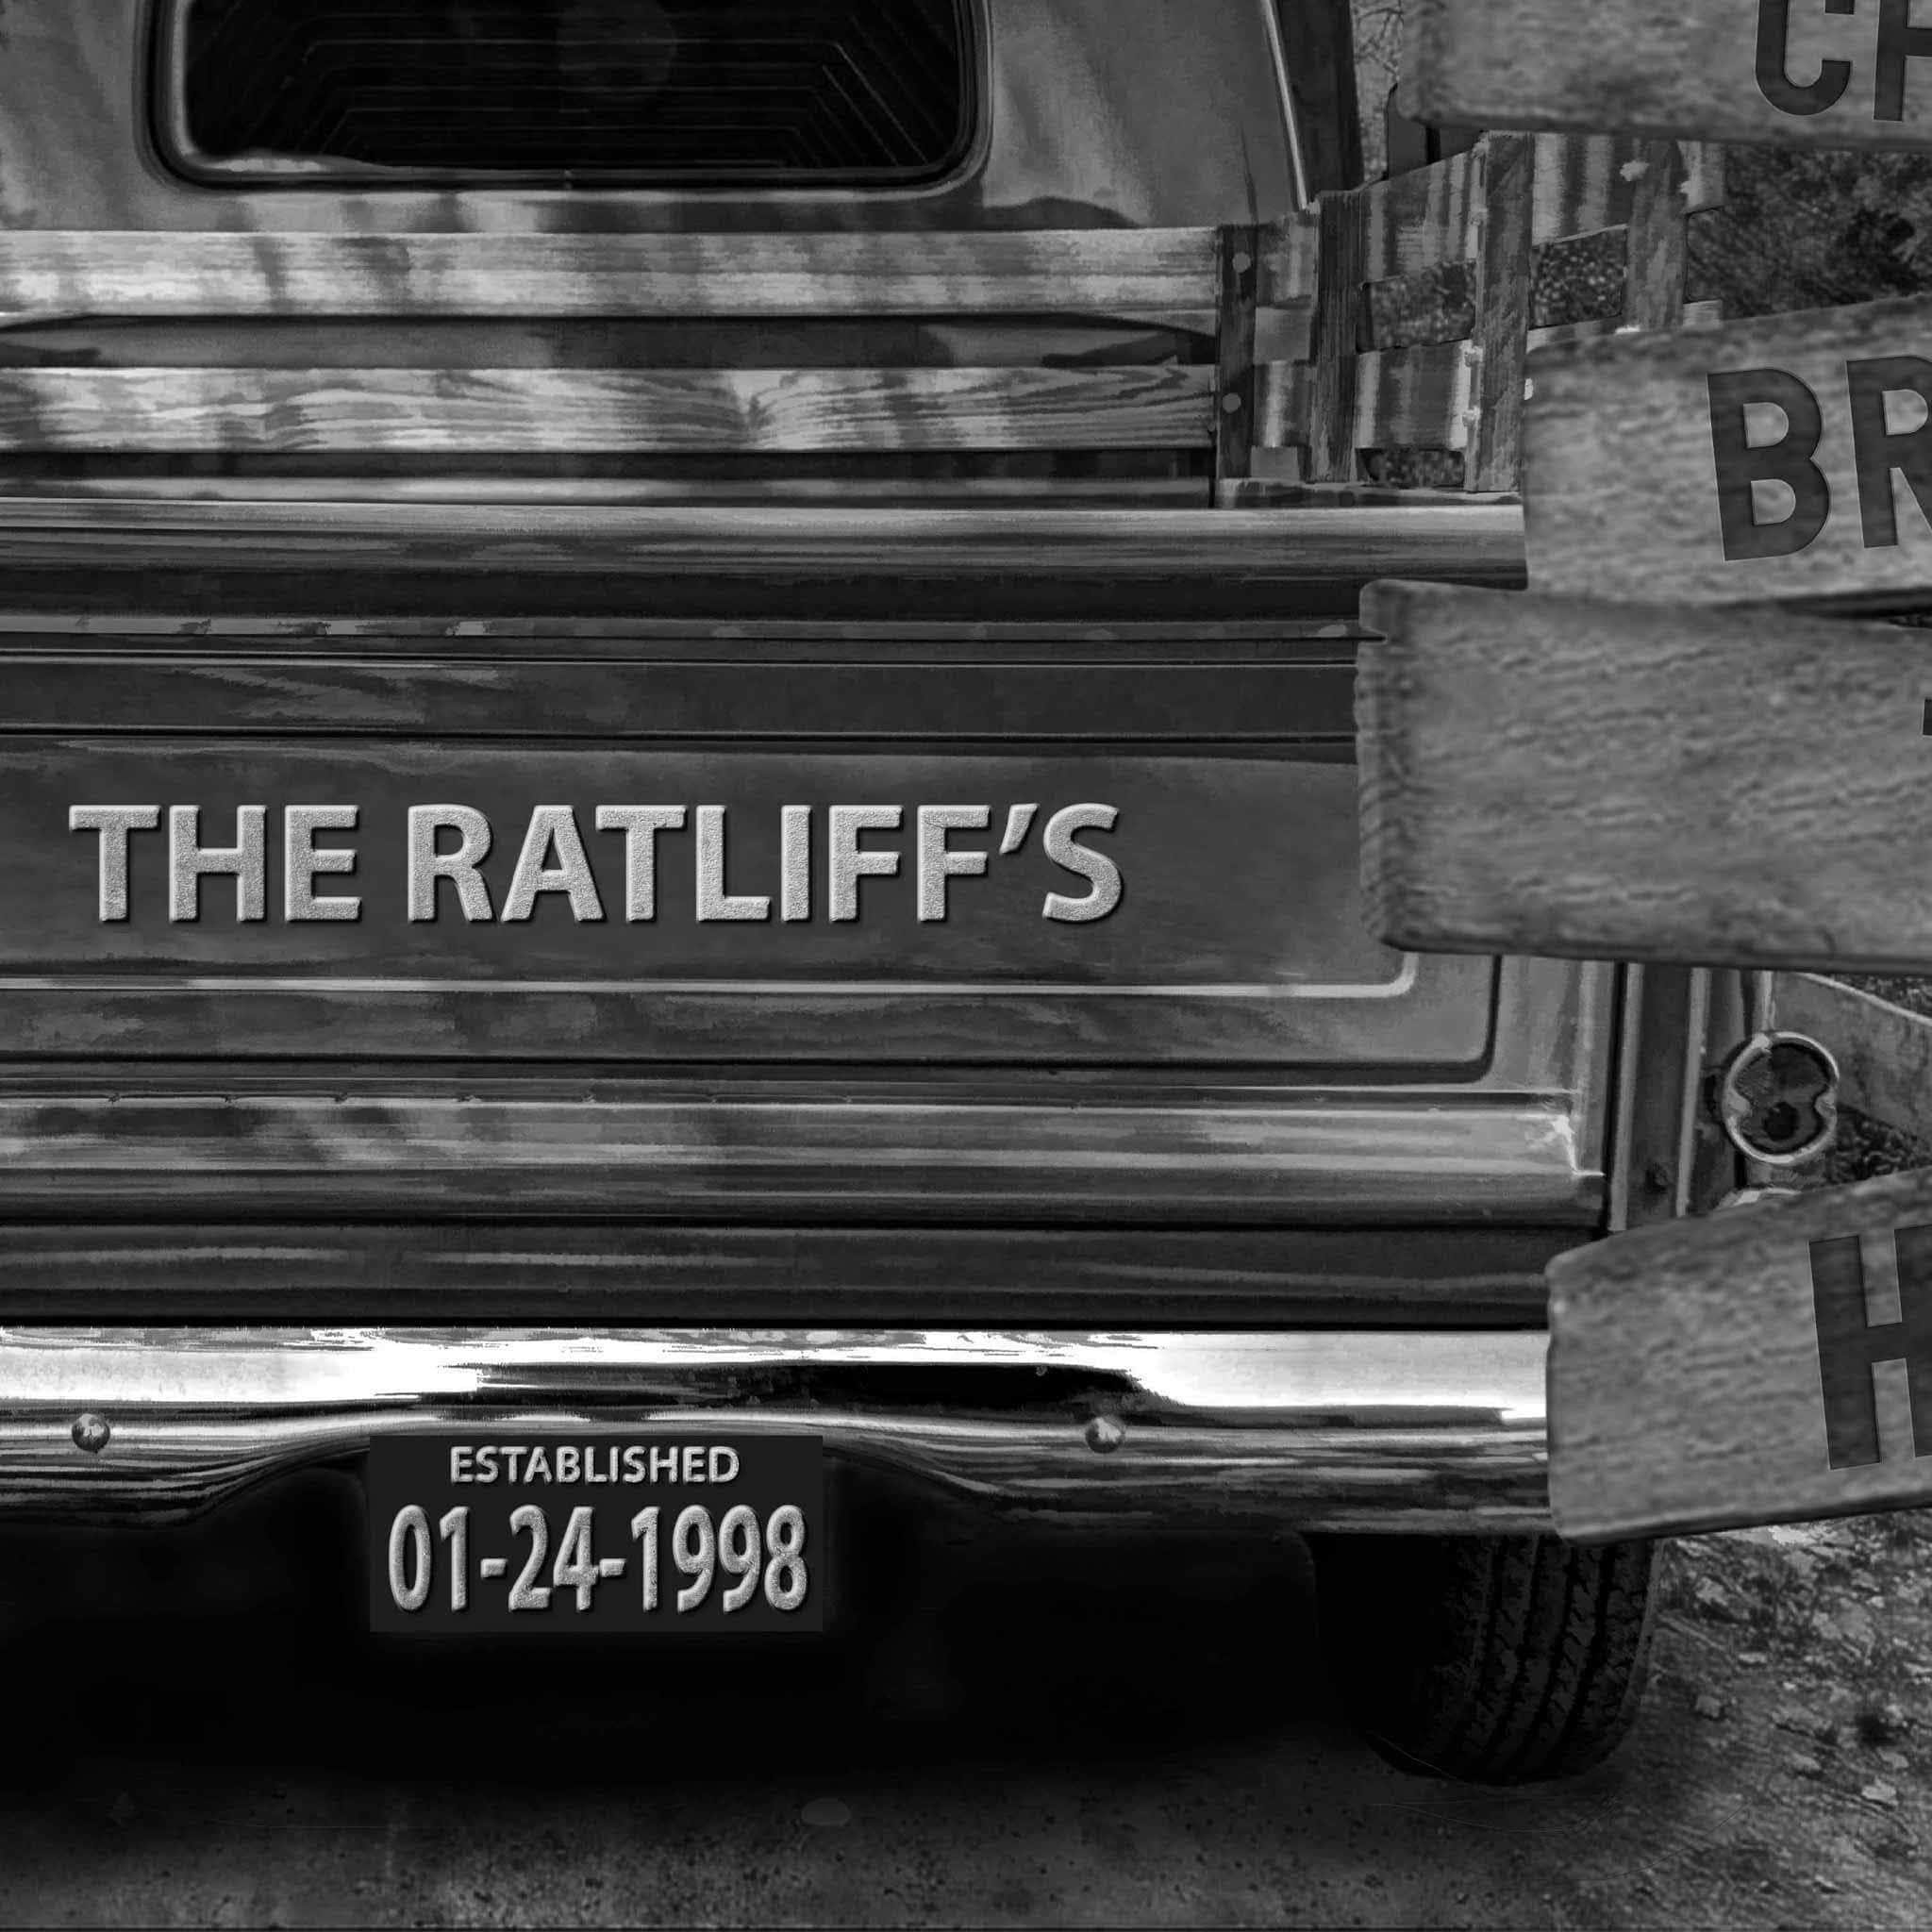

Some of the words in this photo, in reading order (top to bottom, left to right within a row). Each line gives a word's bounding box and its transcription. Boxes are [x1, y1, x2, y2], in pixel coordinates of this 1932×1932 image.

[1707, 356, 1932, 561] BR
[69, 805, 362, 922] THE
[408, 803, 1124, 924] RATLIFF'S
[450, 1446, 740, 1484] ESTABLISHED
[389, 1504, 808, 1613] 01-24-1998
